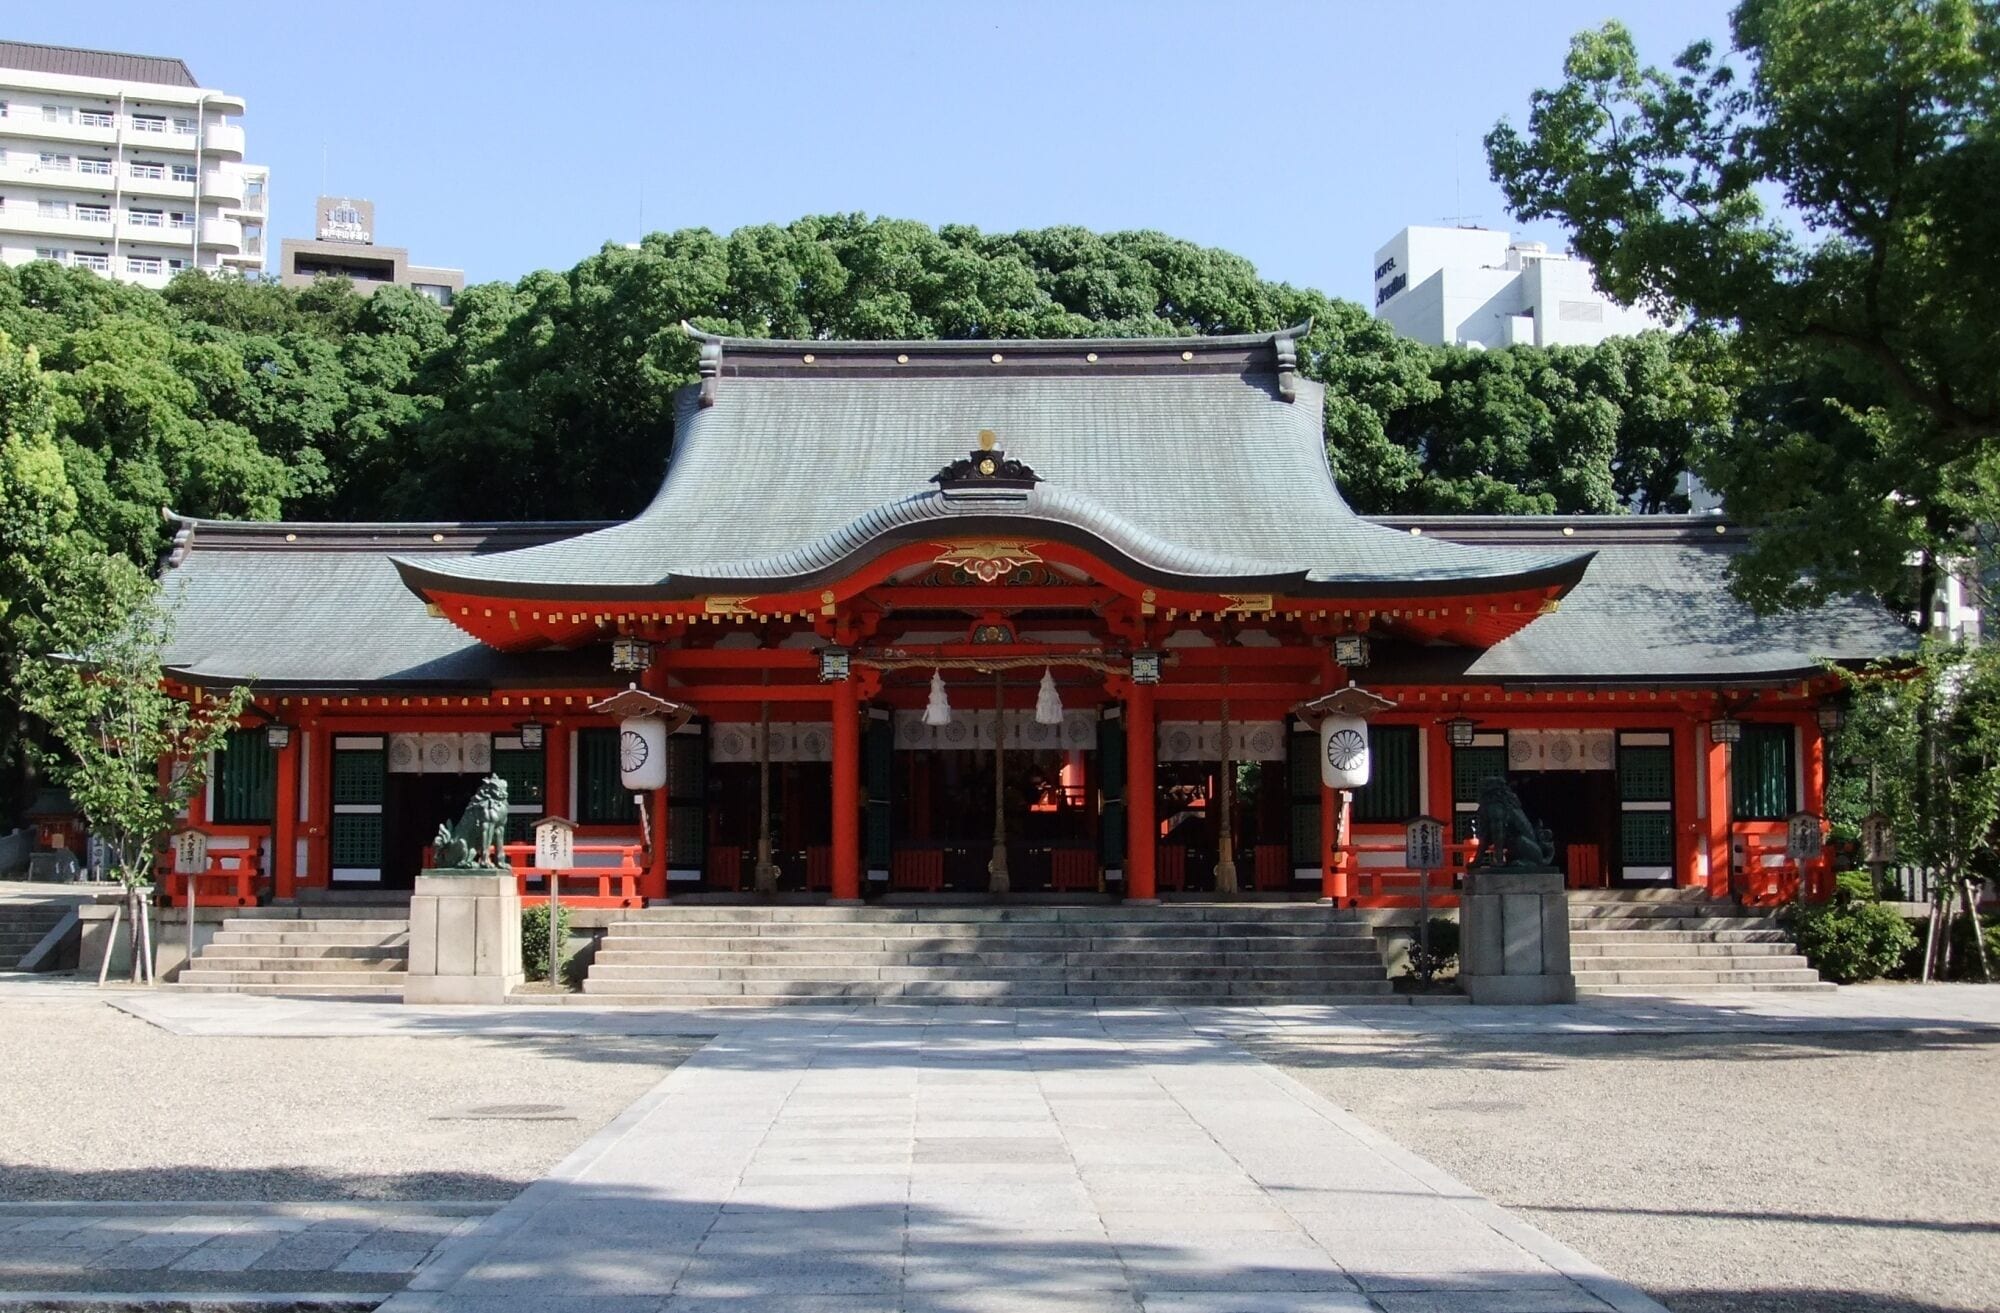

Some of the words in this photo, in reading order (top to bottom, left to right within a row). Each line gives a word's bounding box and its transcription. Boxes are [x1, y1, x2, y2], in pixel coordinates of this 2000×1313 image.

[1375, 256, 1397, 282] HOTEL
[549, 824, 559, 860] 天皇陛下
